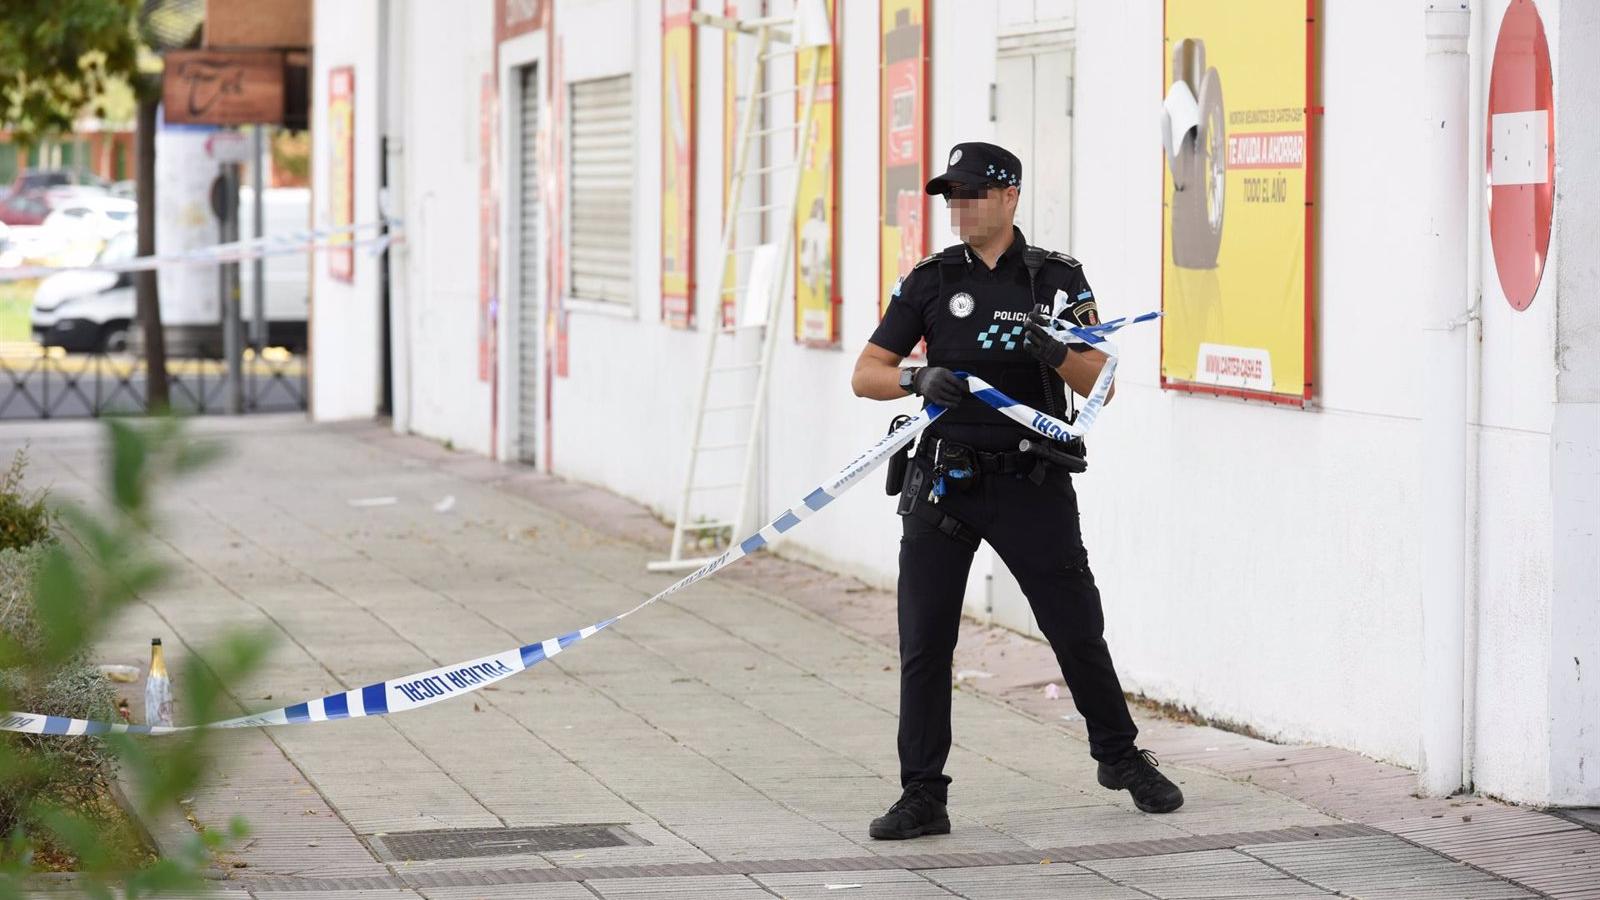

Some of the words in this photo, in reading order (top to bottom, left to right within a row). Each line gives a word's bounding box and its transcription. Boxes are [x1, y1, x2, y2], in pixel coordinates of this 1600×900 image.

[1228, 137, 1237, 165] TE
[1238, 137, 1261, 164] AYUDA
[1261, 136, 1267, 164] A
[1268, 135, 1303, 163] AHORRAR
[1243, 178, 1260, 203] TODO
[1261, 178, 1269, 203] EL
[1270, 171, 1287, 203] AÑO
[394, 675, 453, 702] LOCAL
[445, 659, 513, 689] POLICIA
